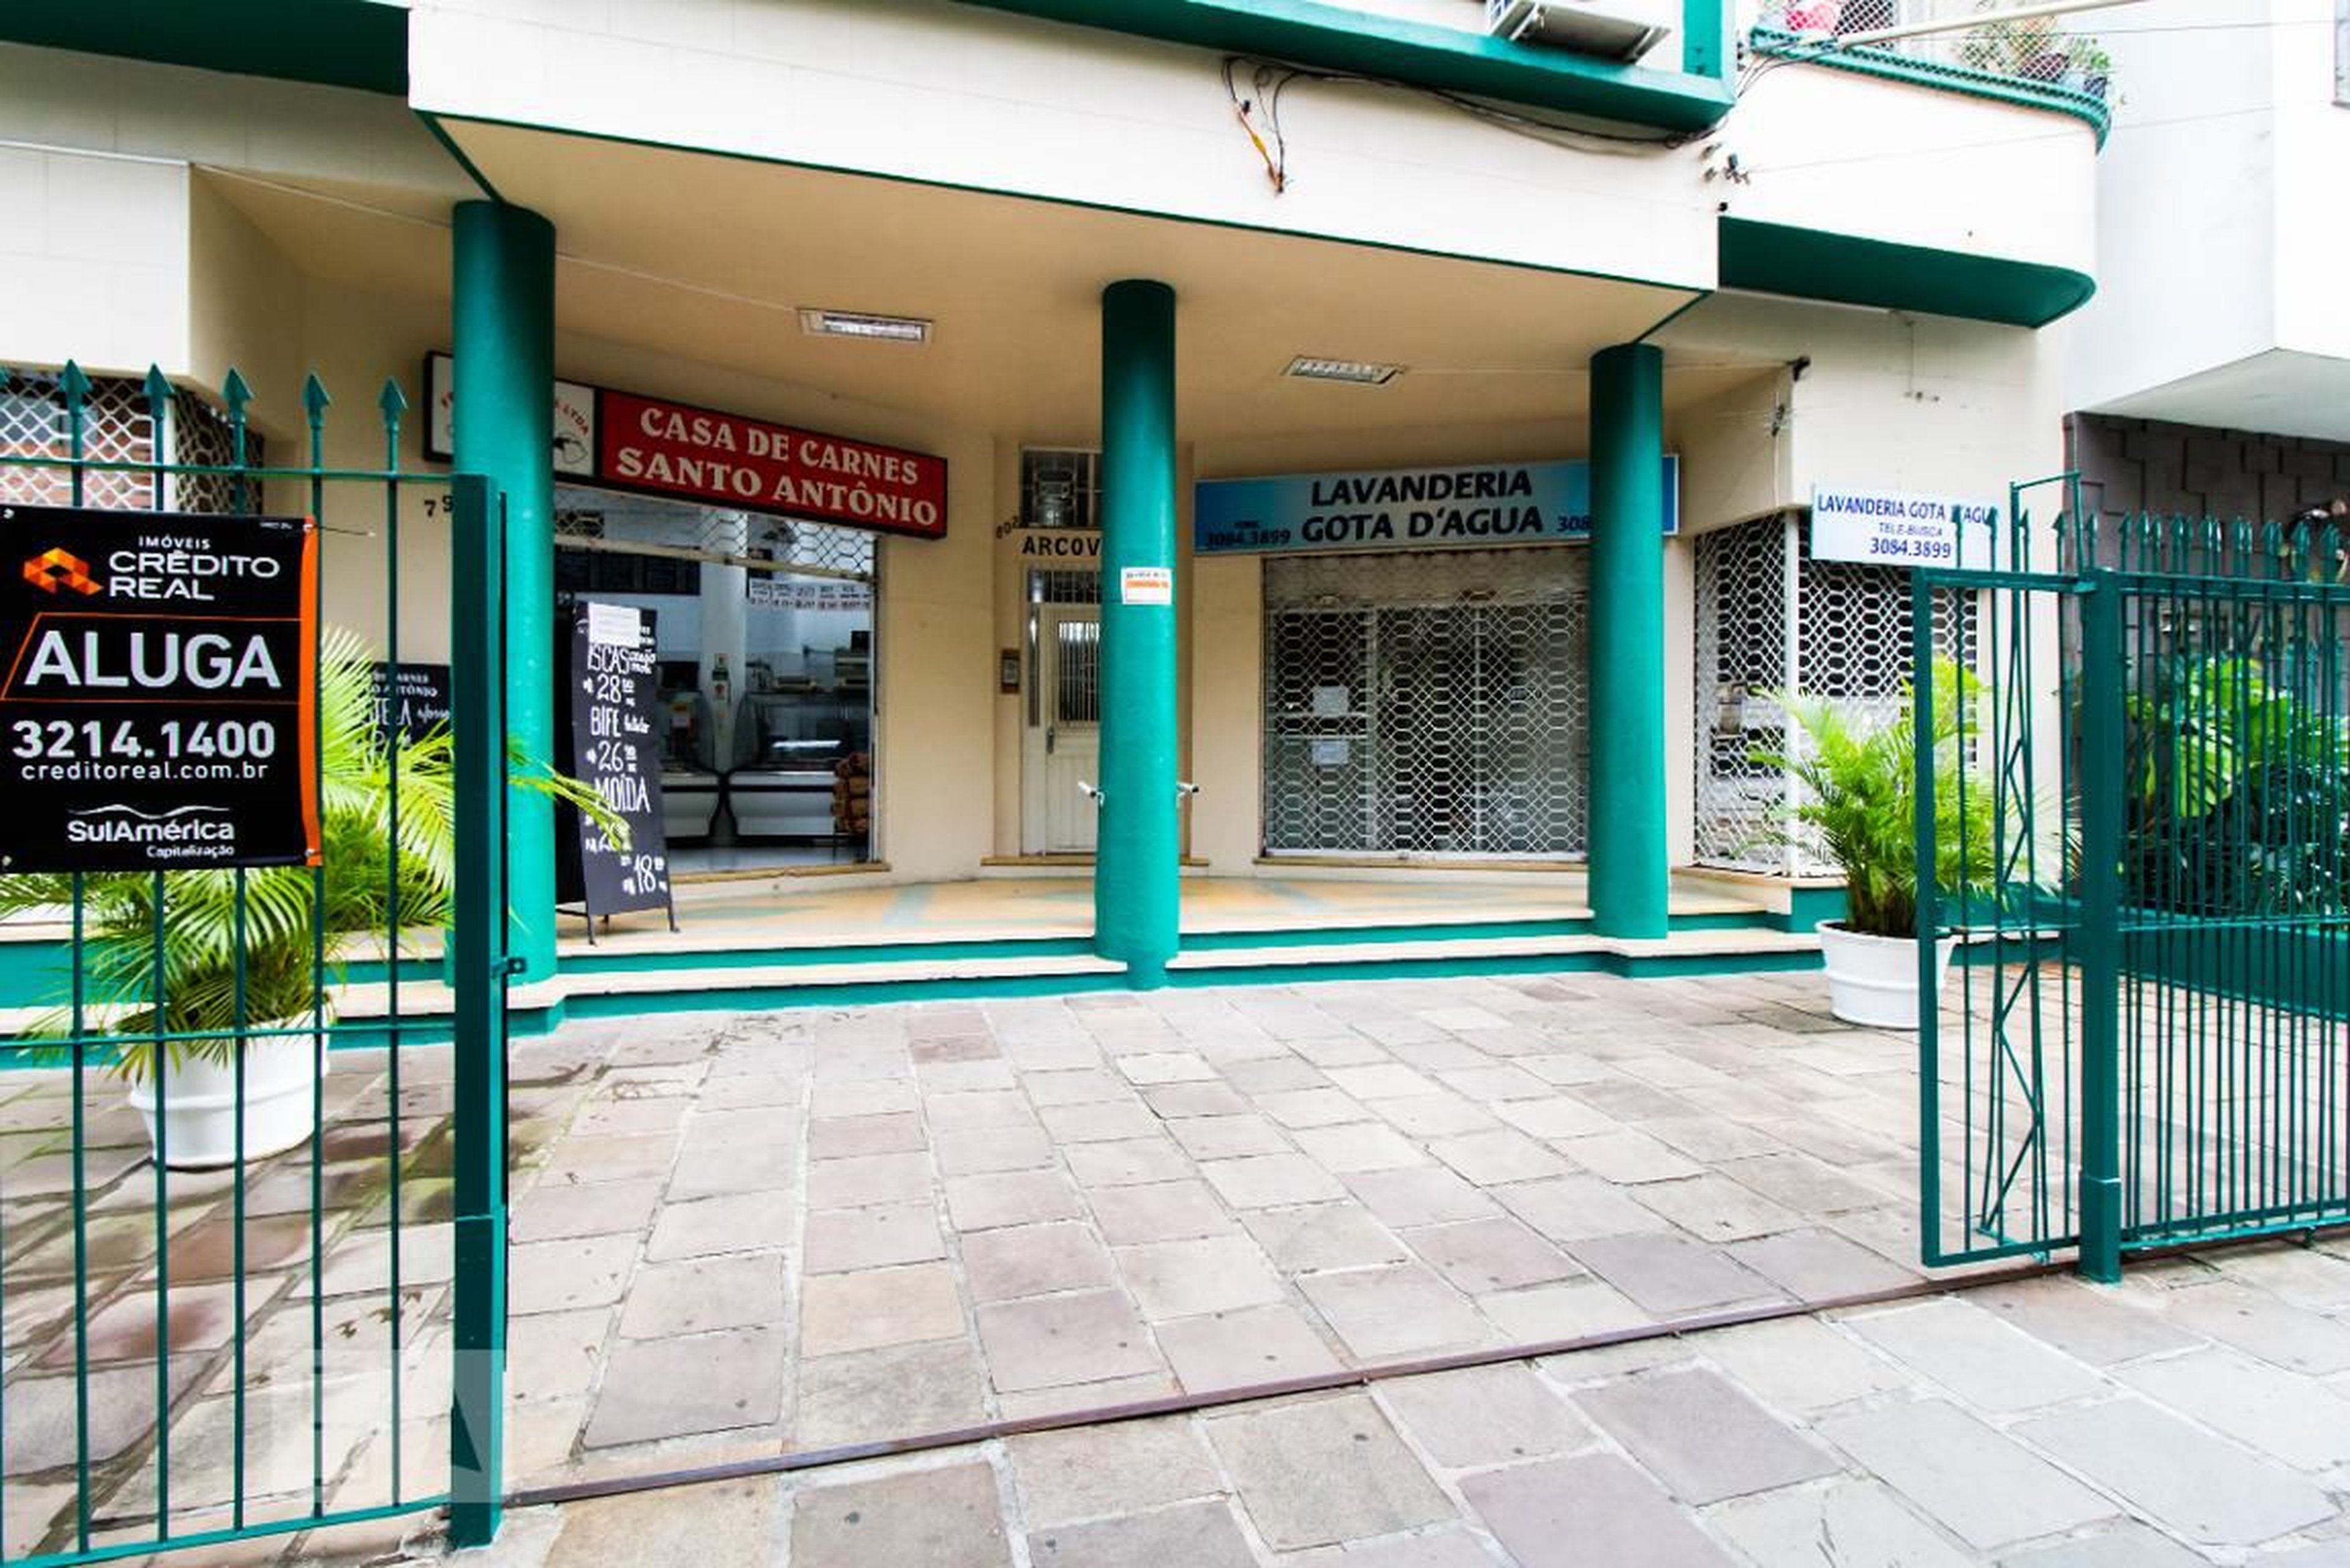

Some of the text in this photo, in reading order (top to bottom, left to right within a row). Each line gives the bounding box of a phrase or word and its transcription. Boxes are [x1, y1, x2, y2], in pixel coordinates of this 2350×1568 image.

[641, 408, 918, 485] CASA DE CARNES
[617, 447, 939, 525] SANTO ANTÔNIO
[1311, 469, 1532, 506] LAVANDERIA
[1818, 495, 1905, 519] LAVANDERIA
[1909, 502, 1945, 521] GOTA
[1302, 506, 1544, 542] GOTA D'AGUA
[139, 535, 211, 550] IMÓVEIS
[1870, 538, 1952, 559] 3084.3899
[109, 549, 280, 578] CRÉDITO
[110, 578, 215, 600] REAL
[24, 630, 282, 689] ALUGA
[591, 706, 622, 737] BIFE
[12, 720, 275, 758] 3214.1400
[21, 761, 269, 780] creditoreal.com.br
[67, 820, 235, 842] SulAmérica
[147, 845, 235, 859] Capitalização
